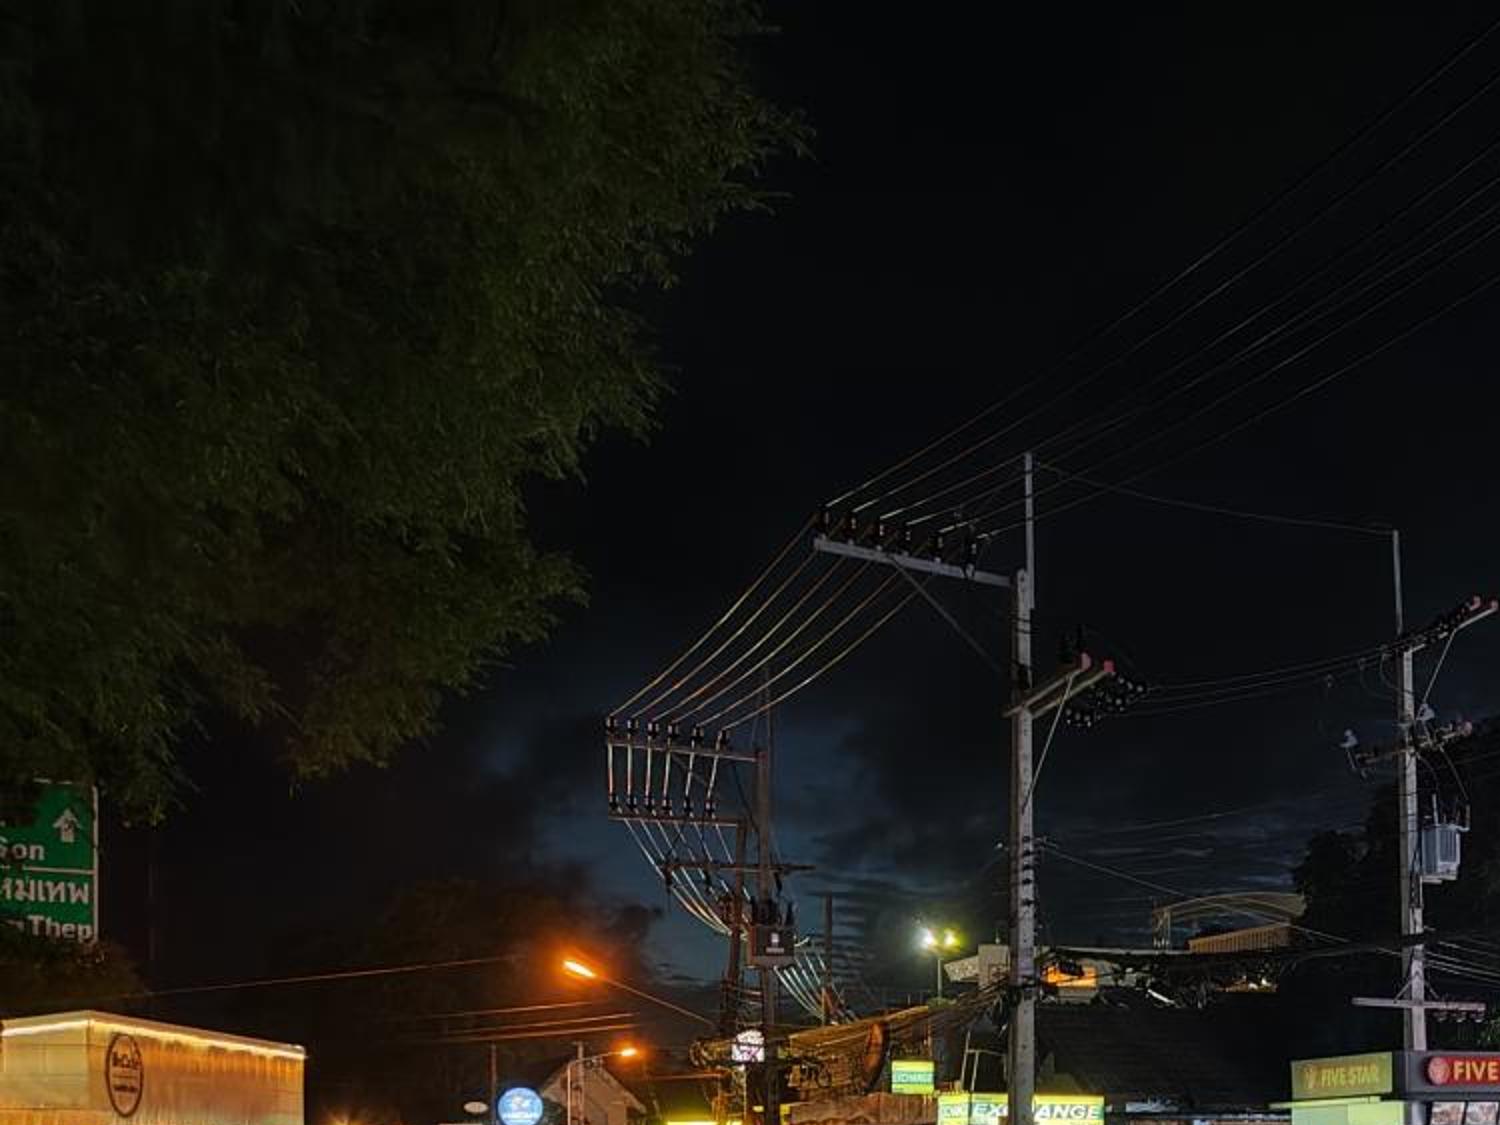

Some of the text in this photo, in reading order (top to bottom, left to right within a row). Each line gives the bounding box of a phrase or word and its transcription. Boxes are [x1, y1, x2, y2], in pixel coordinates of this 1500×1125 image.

[28, 914, 93, 943] Thep
[1321, 1064, 1379, 1087] FIVE STAR
[1453, 1062, 1499, 1081] FIVE
[974, 1103, 1100, 1119] EXANGE
